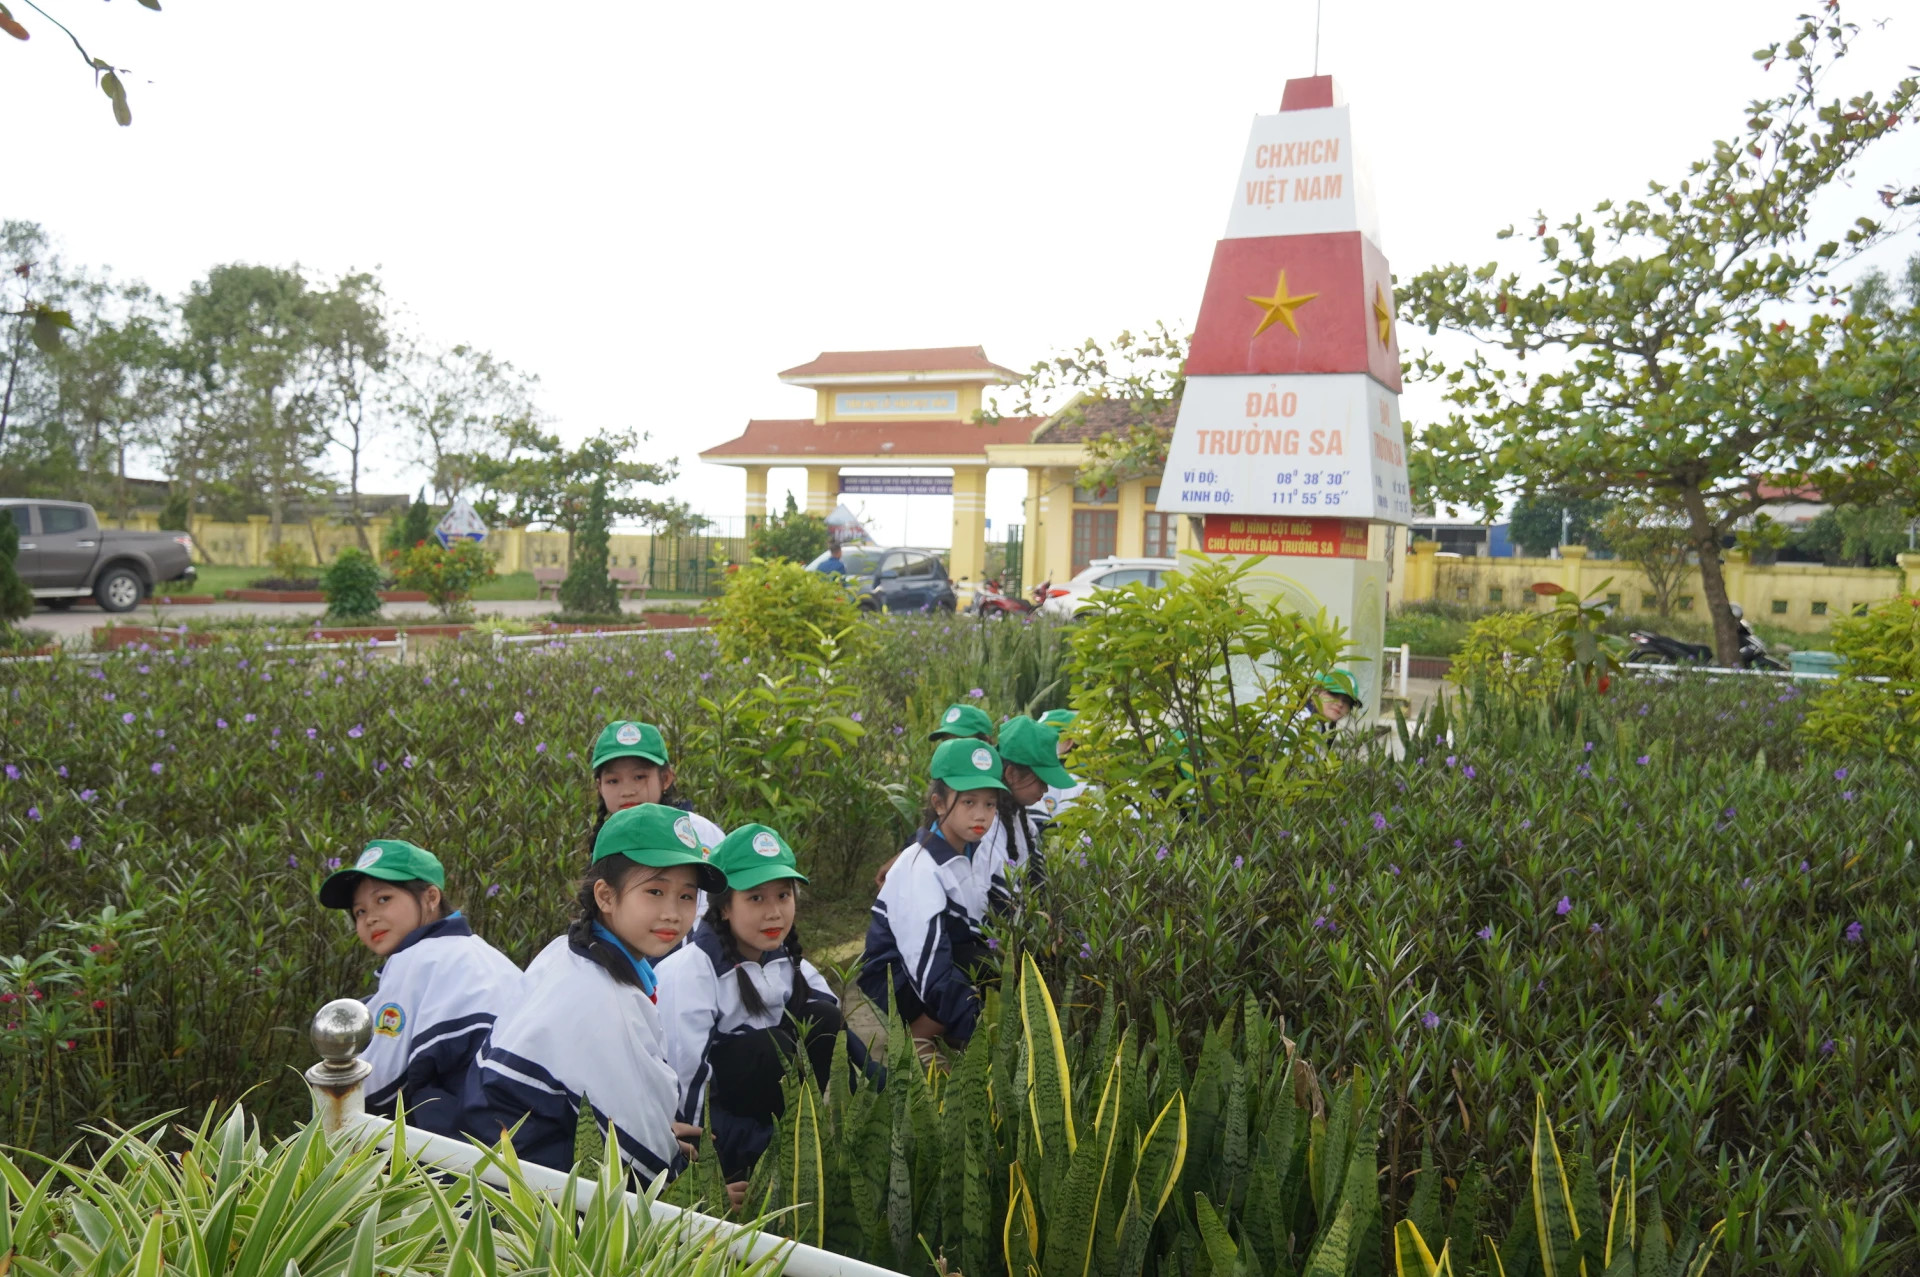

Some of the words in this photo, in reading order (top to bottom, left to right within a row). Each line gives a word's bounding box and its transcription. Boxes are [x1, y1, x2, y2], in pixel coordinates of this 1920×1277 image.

[1255, 138, 1340, 169] CHXHCN
[1246, 174, 1289, 210] VIỆT
[1294, 174, 1343, 202] NAM
[1245, 383, 1298, 418] ĐẢO
[1196, 422, 1300, 456] TRƯỜNG
[1308, 429, 1343, 456] SA
[1182, 490, 1210, 502] KINH
[1320, 541, 1334, 554] SA
